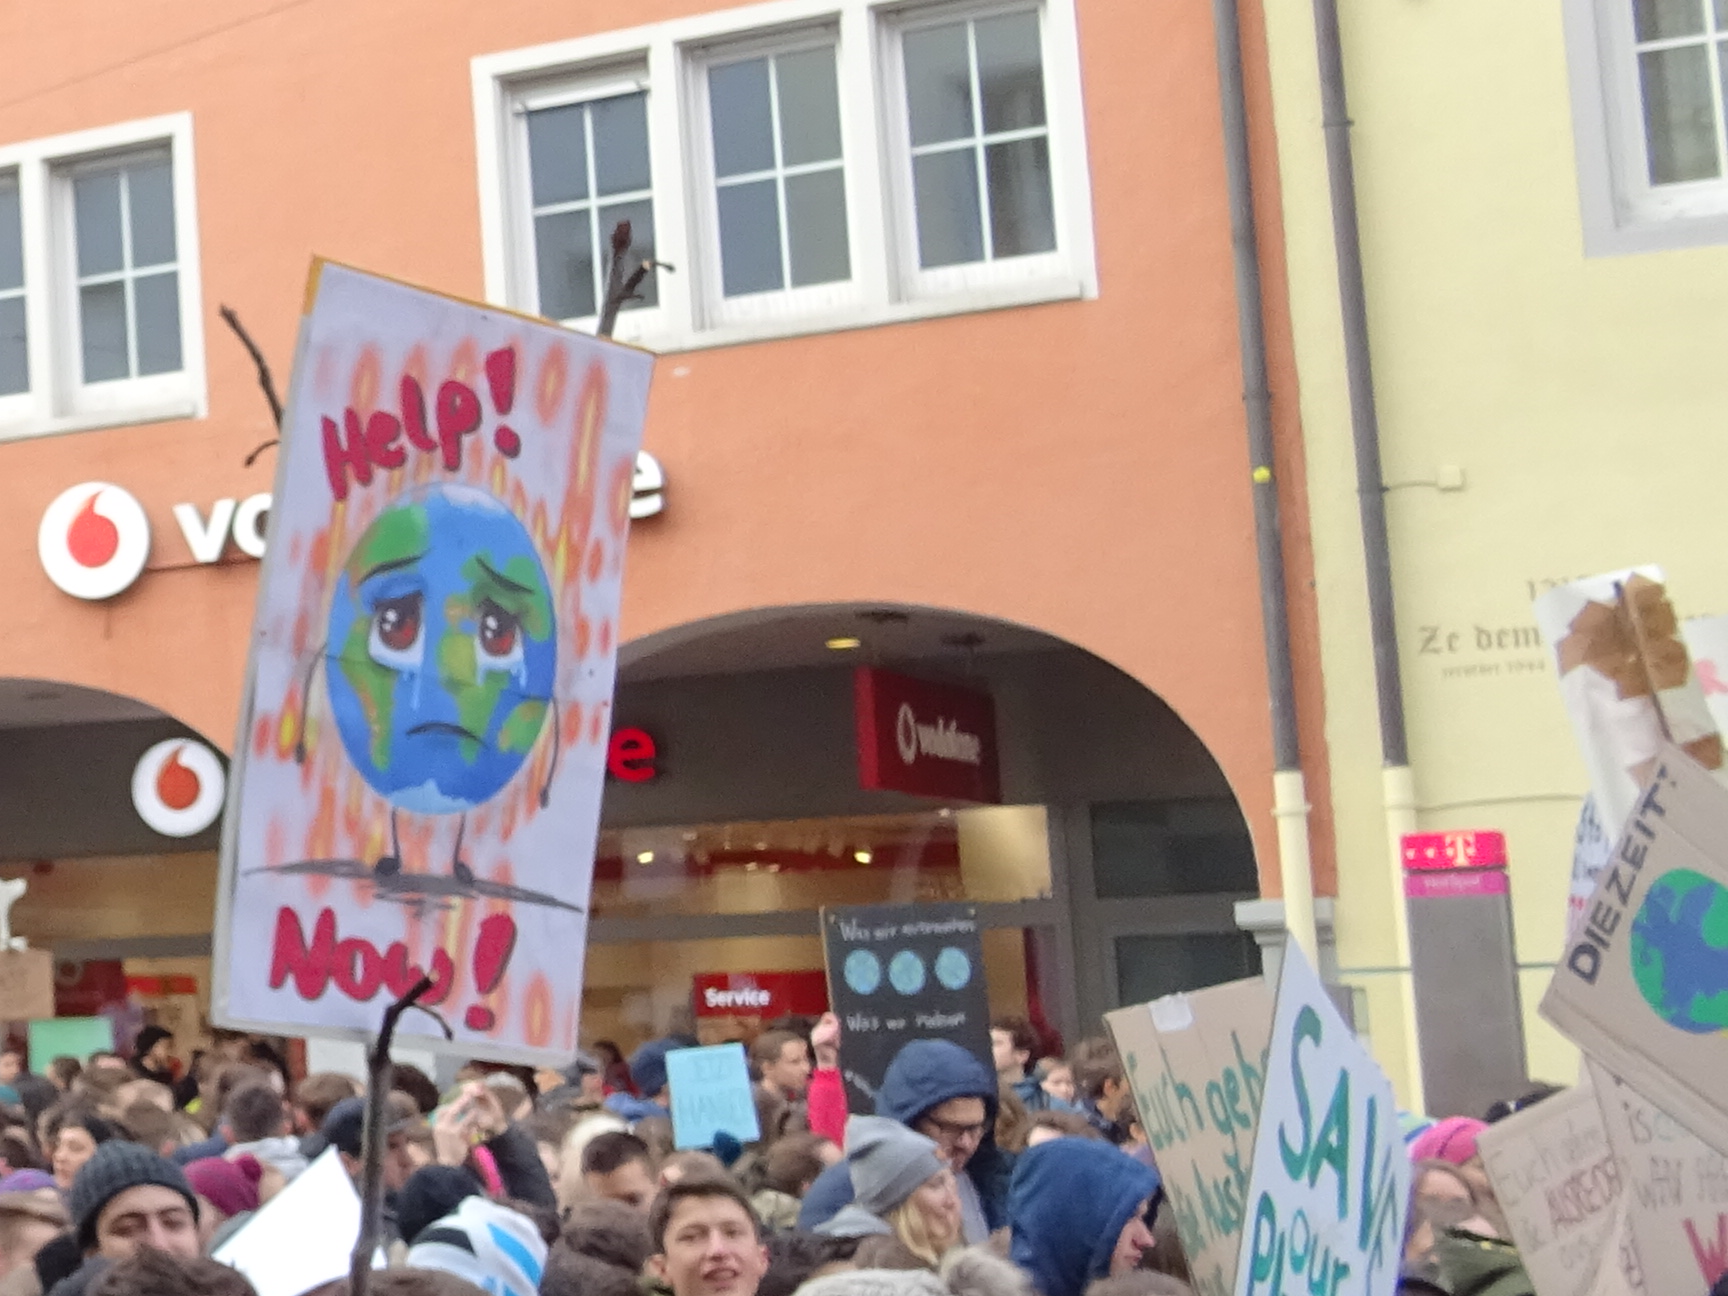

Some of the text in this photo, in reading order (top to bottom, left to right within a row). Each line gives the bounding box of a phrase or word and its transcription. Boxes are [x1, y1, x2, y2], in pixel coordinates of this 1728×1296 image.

[320, 345, 522, 502] Help!
[268, 905, 519, 1032] Now!
[703, 985, 771, 1008] Service
[1567, 901, 1623, 987] DIE
